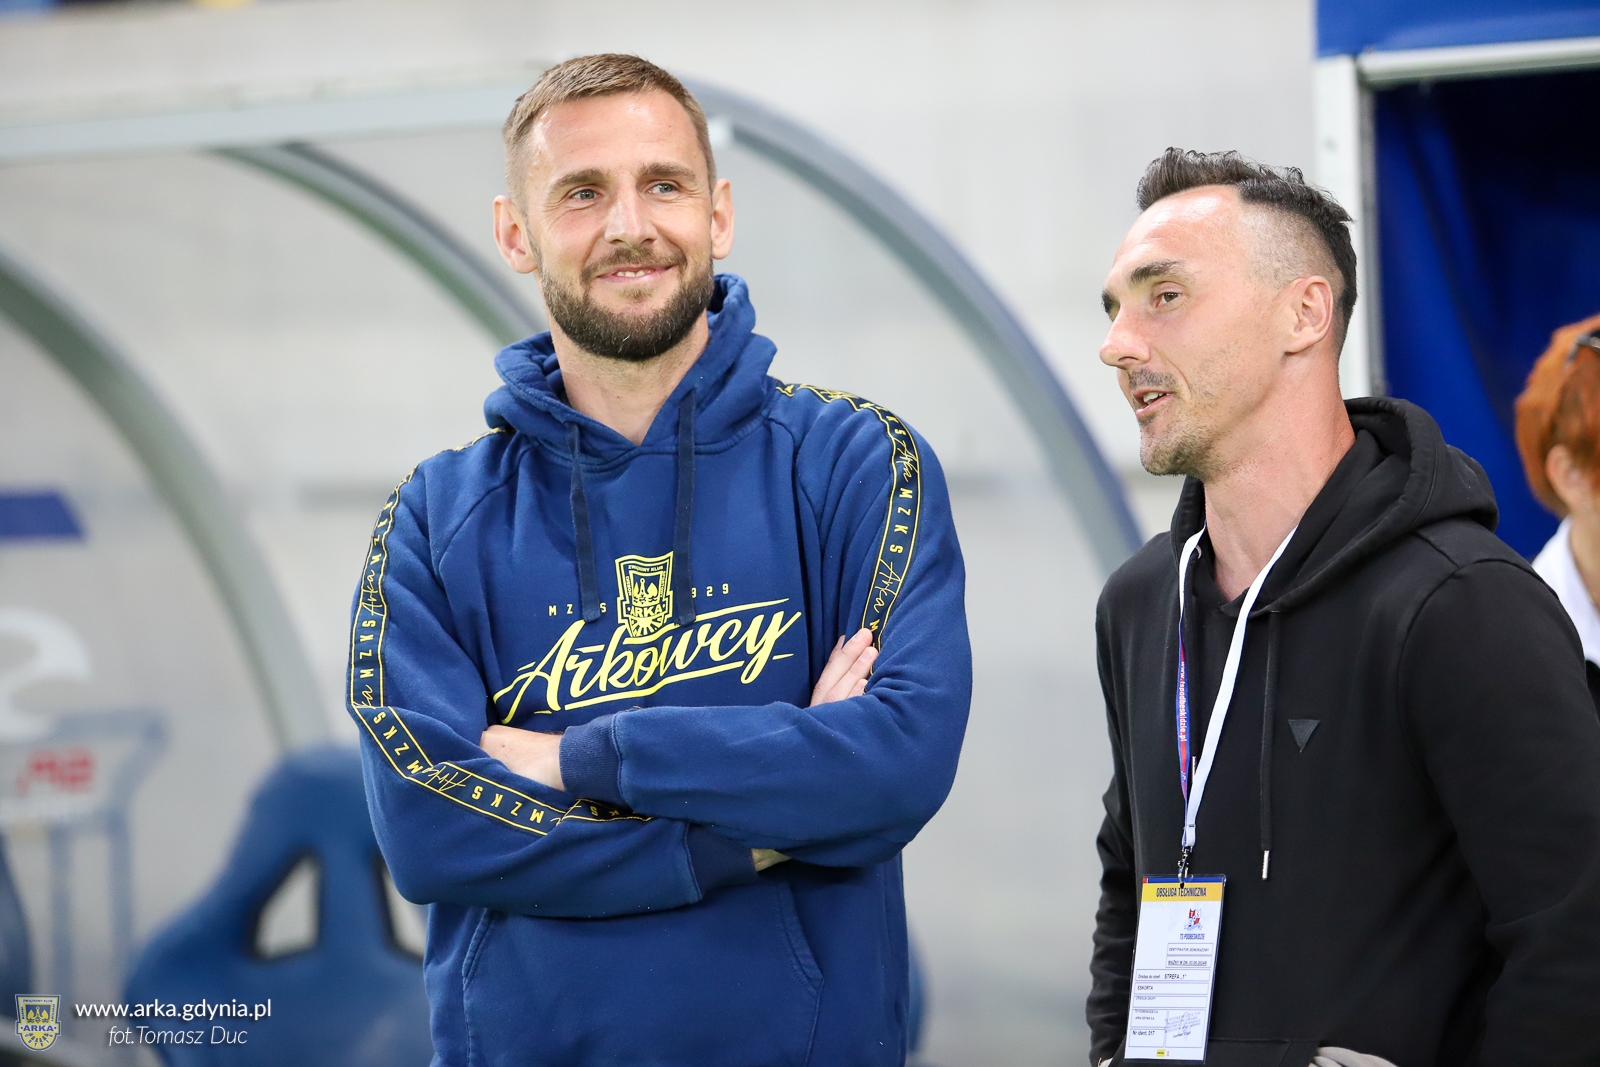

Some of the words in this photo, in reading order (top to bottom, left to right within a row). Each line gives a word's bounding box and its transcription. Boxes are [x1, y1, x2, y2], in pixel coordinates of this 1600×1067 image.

[889, 487, 913, 554] MZKS
[362, 569, 386, 616] Arka
[548, 601, 607, 616] MZS
[630, 603, 663, 618] ARKA
[873, 559, 901, 614] Arka
[359, 619, 377, 679] MZKS
[493, 610, 802, 724] Arkowcy
[373, 711, 424, 775] MZKS
[471, 785, 545, 824] MZKS
